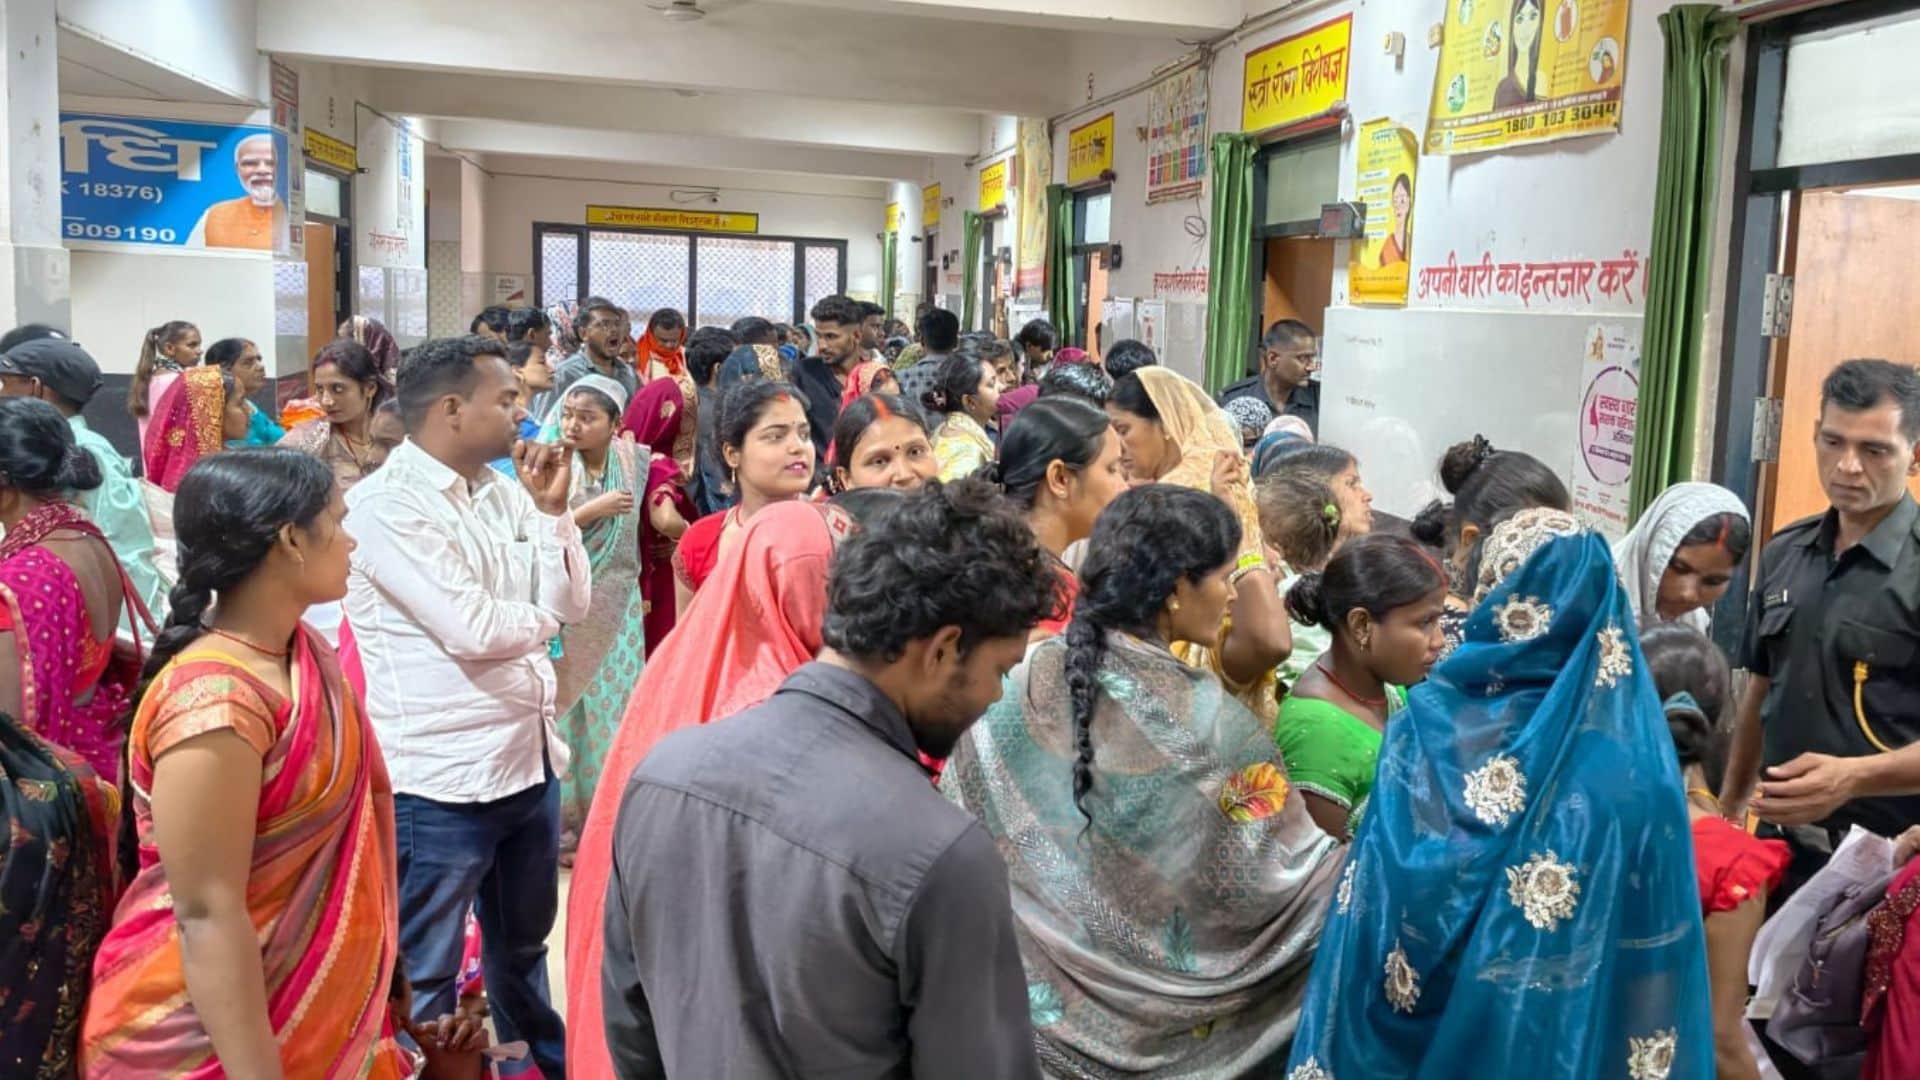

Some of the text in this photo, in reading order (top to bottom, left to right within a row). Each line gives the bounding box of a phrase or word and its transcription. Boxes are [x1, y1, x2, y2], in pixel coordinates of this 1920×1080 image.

[1272, 60, 1299, 105] रोग
[1504, 116, 1536, 134] 1800
[1541, 107, 1567, 128] 103
[61, 119, 217, 181] धि
[79, 182, 163, 203] 18376)
[66, 222, 177, 243] 909190
